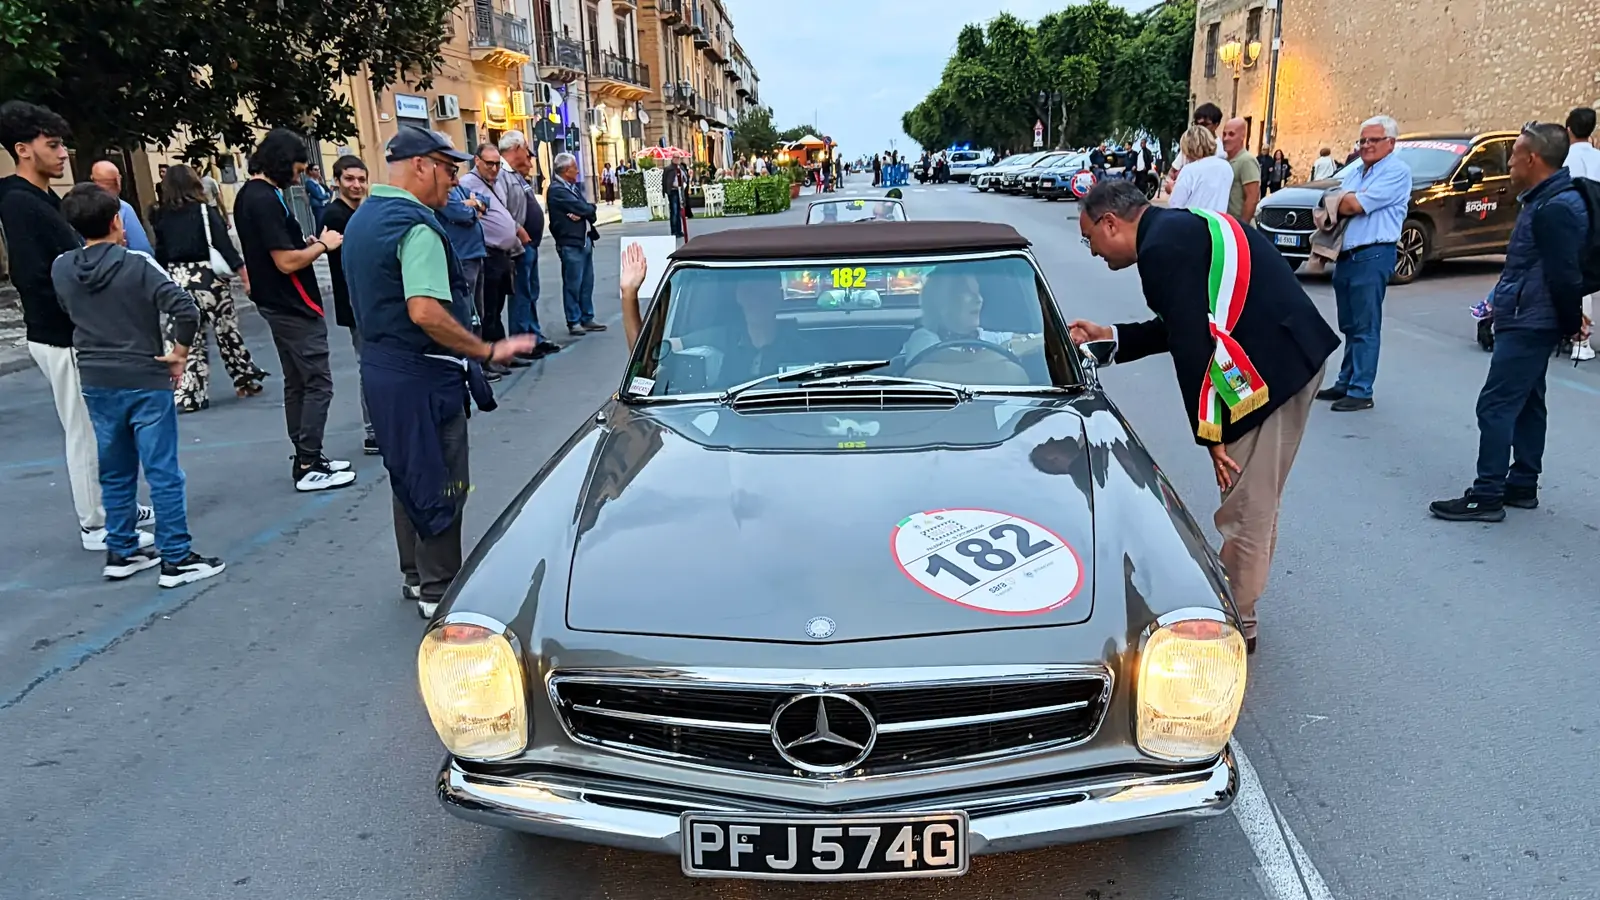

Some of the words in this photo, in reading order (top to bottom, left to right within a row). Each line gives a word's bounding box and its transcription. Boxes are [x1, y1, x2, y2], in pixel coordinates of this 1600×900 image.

[1465, 201, 1497, 213] SPORTS
[831, 267, 867, 288] 182
[925, 523, 1055, 587] 182
[988, 581, 1008, 594] sara
